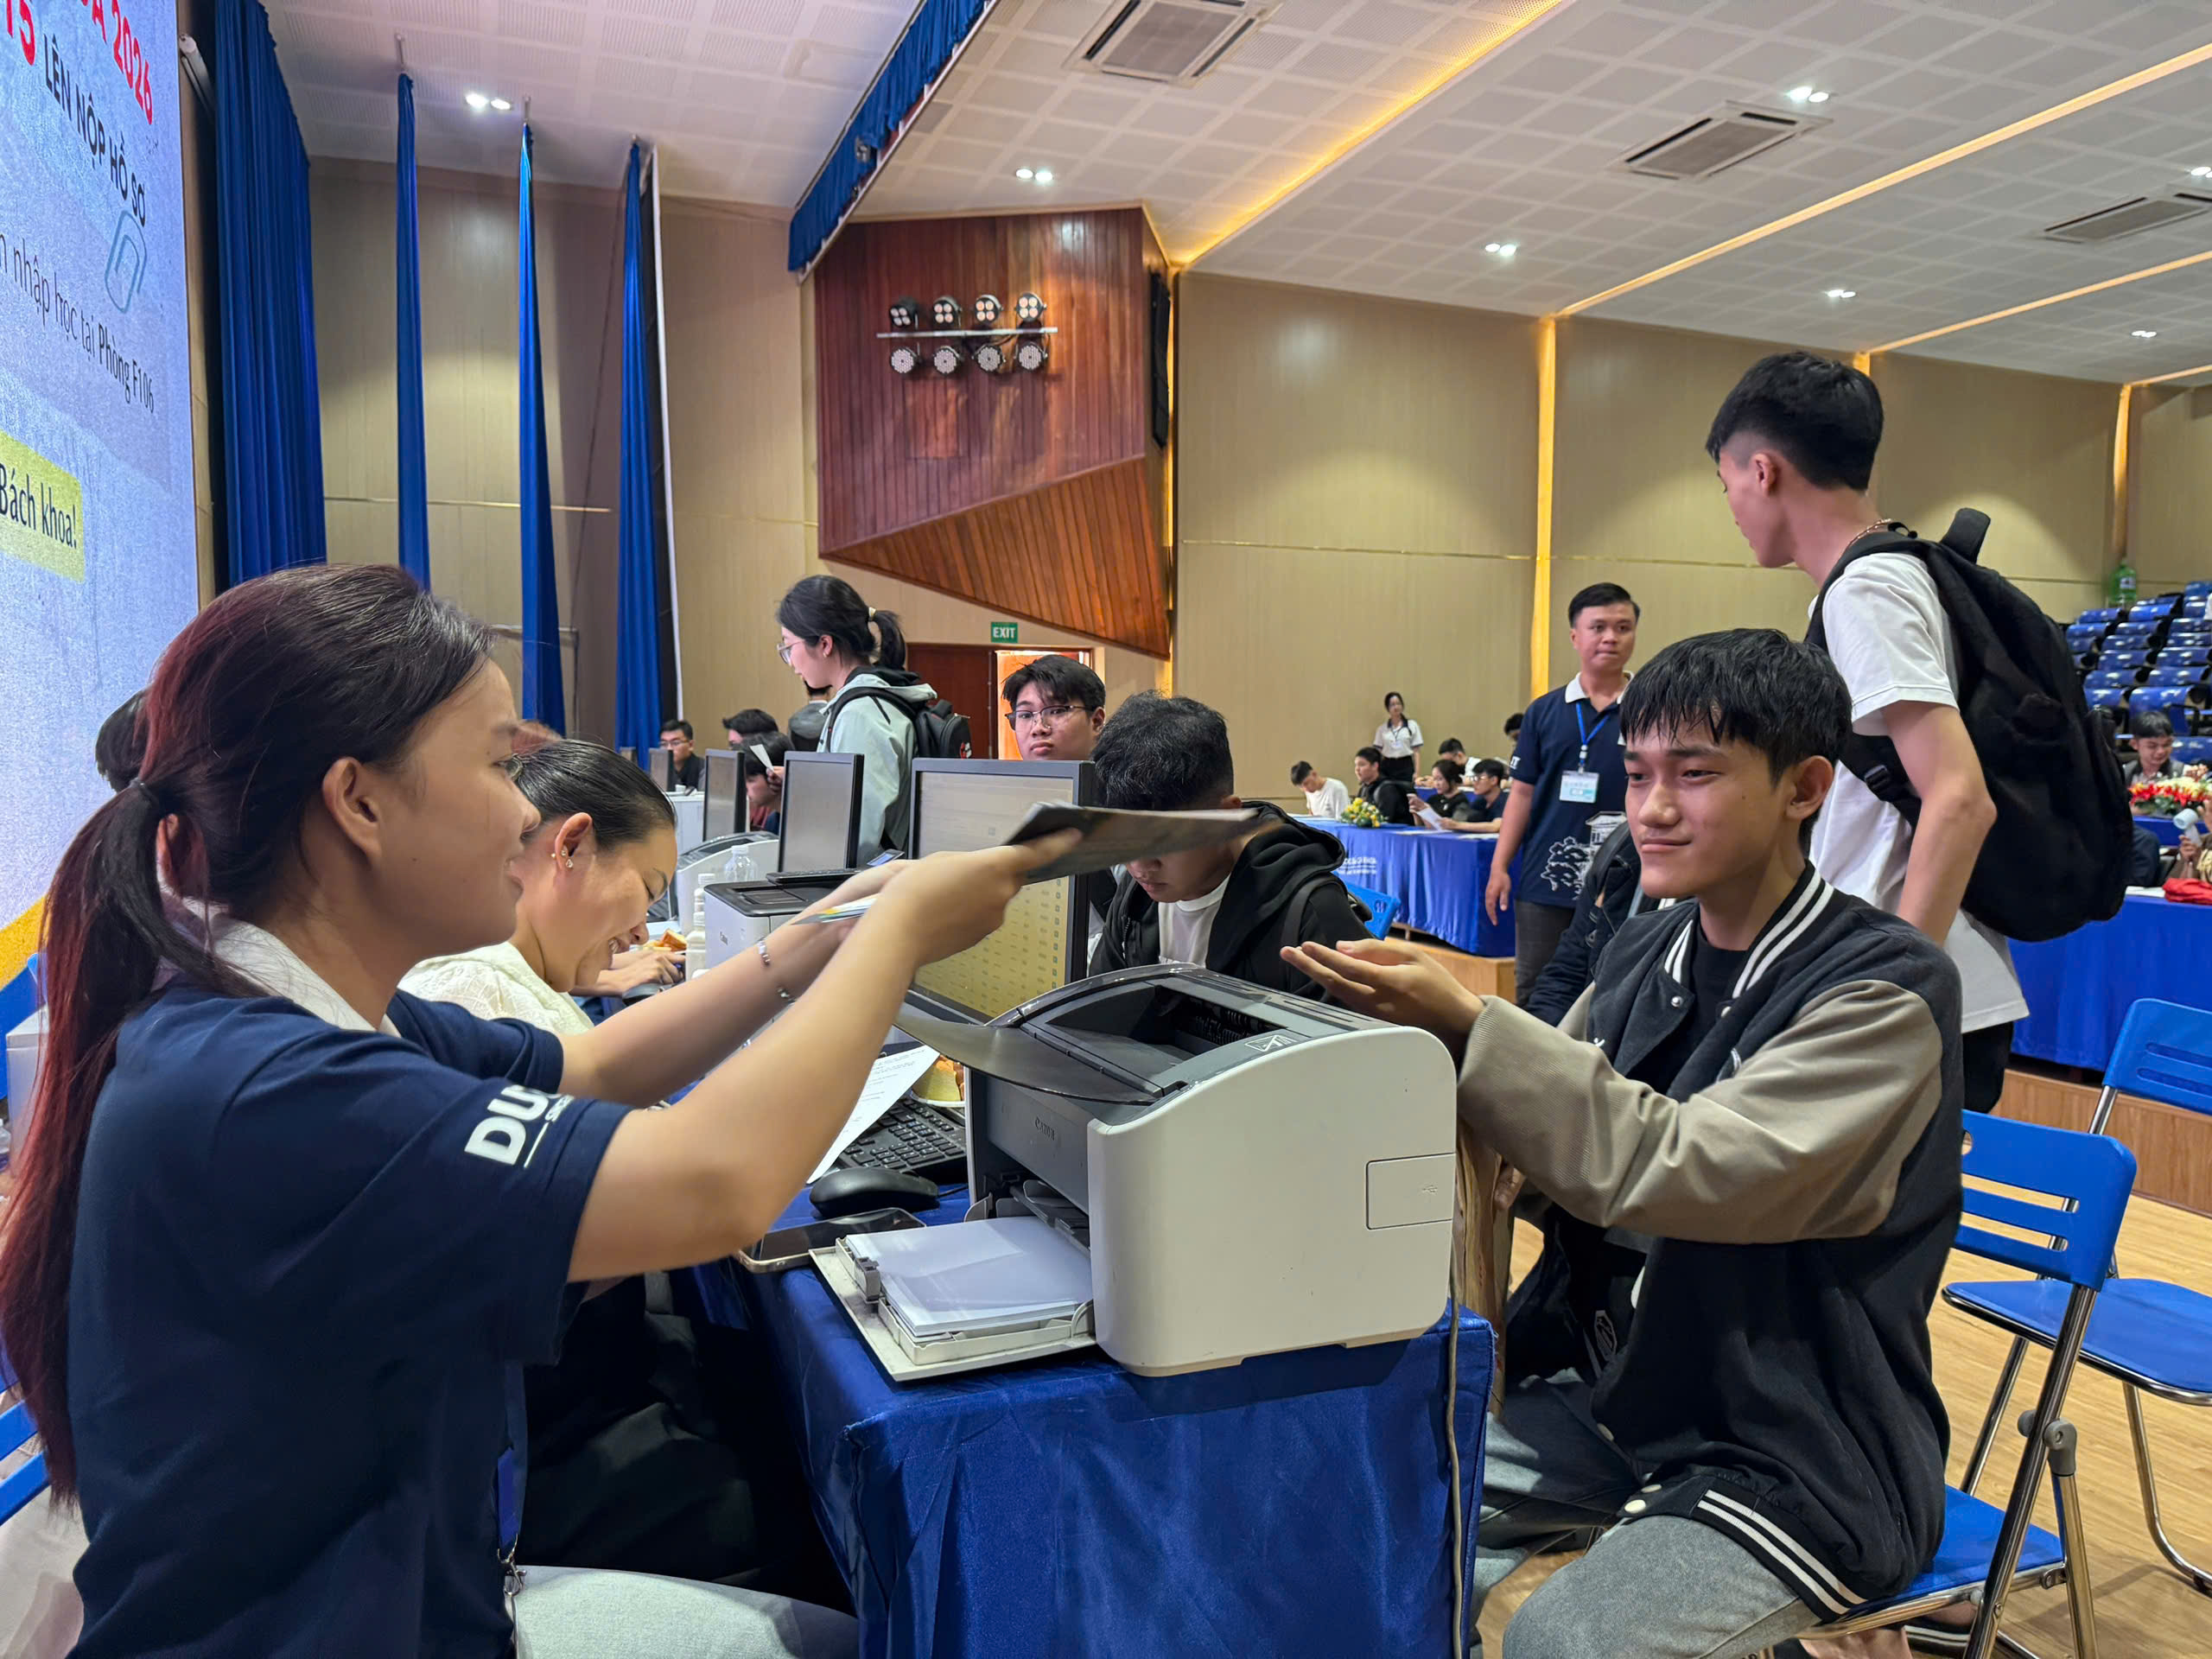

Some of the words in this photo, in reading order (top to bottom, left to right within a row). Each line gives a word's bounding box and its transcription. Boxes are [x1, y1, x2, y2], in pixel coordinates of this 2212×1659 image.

[44, 33, 72, 121] LÊN
[75, 83, 105, 169] NỘP
[13, 238, 50, 327] nhập
[54, 271, 77, 340] học
[80, 309, 95, 361] tại
[99, 322, 131, 404] Phòng
[132, 359, 154, 413] F106
[993, 626, 1016, 639] EXIT
